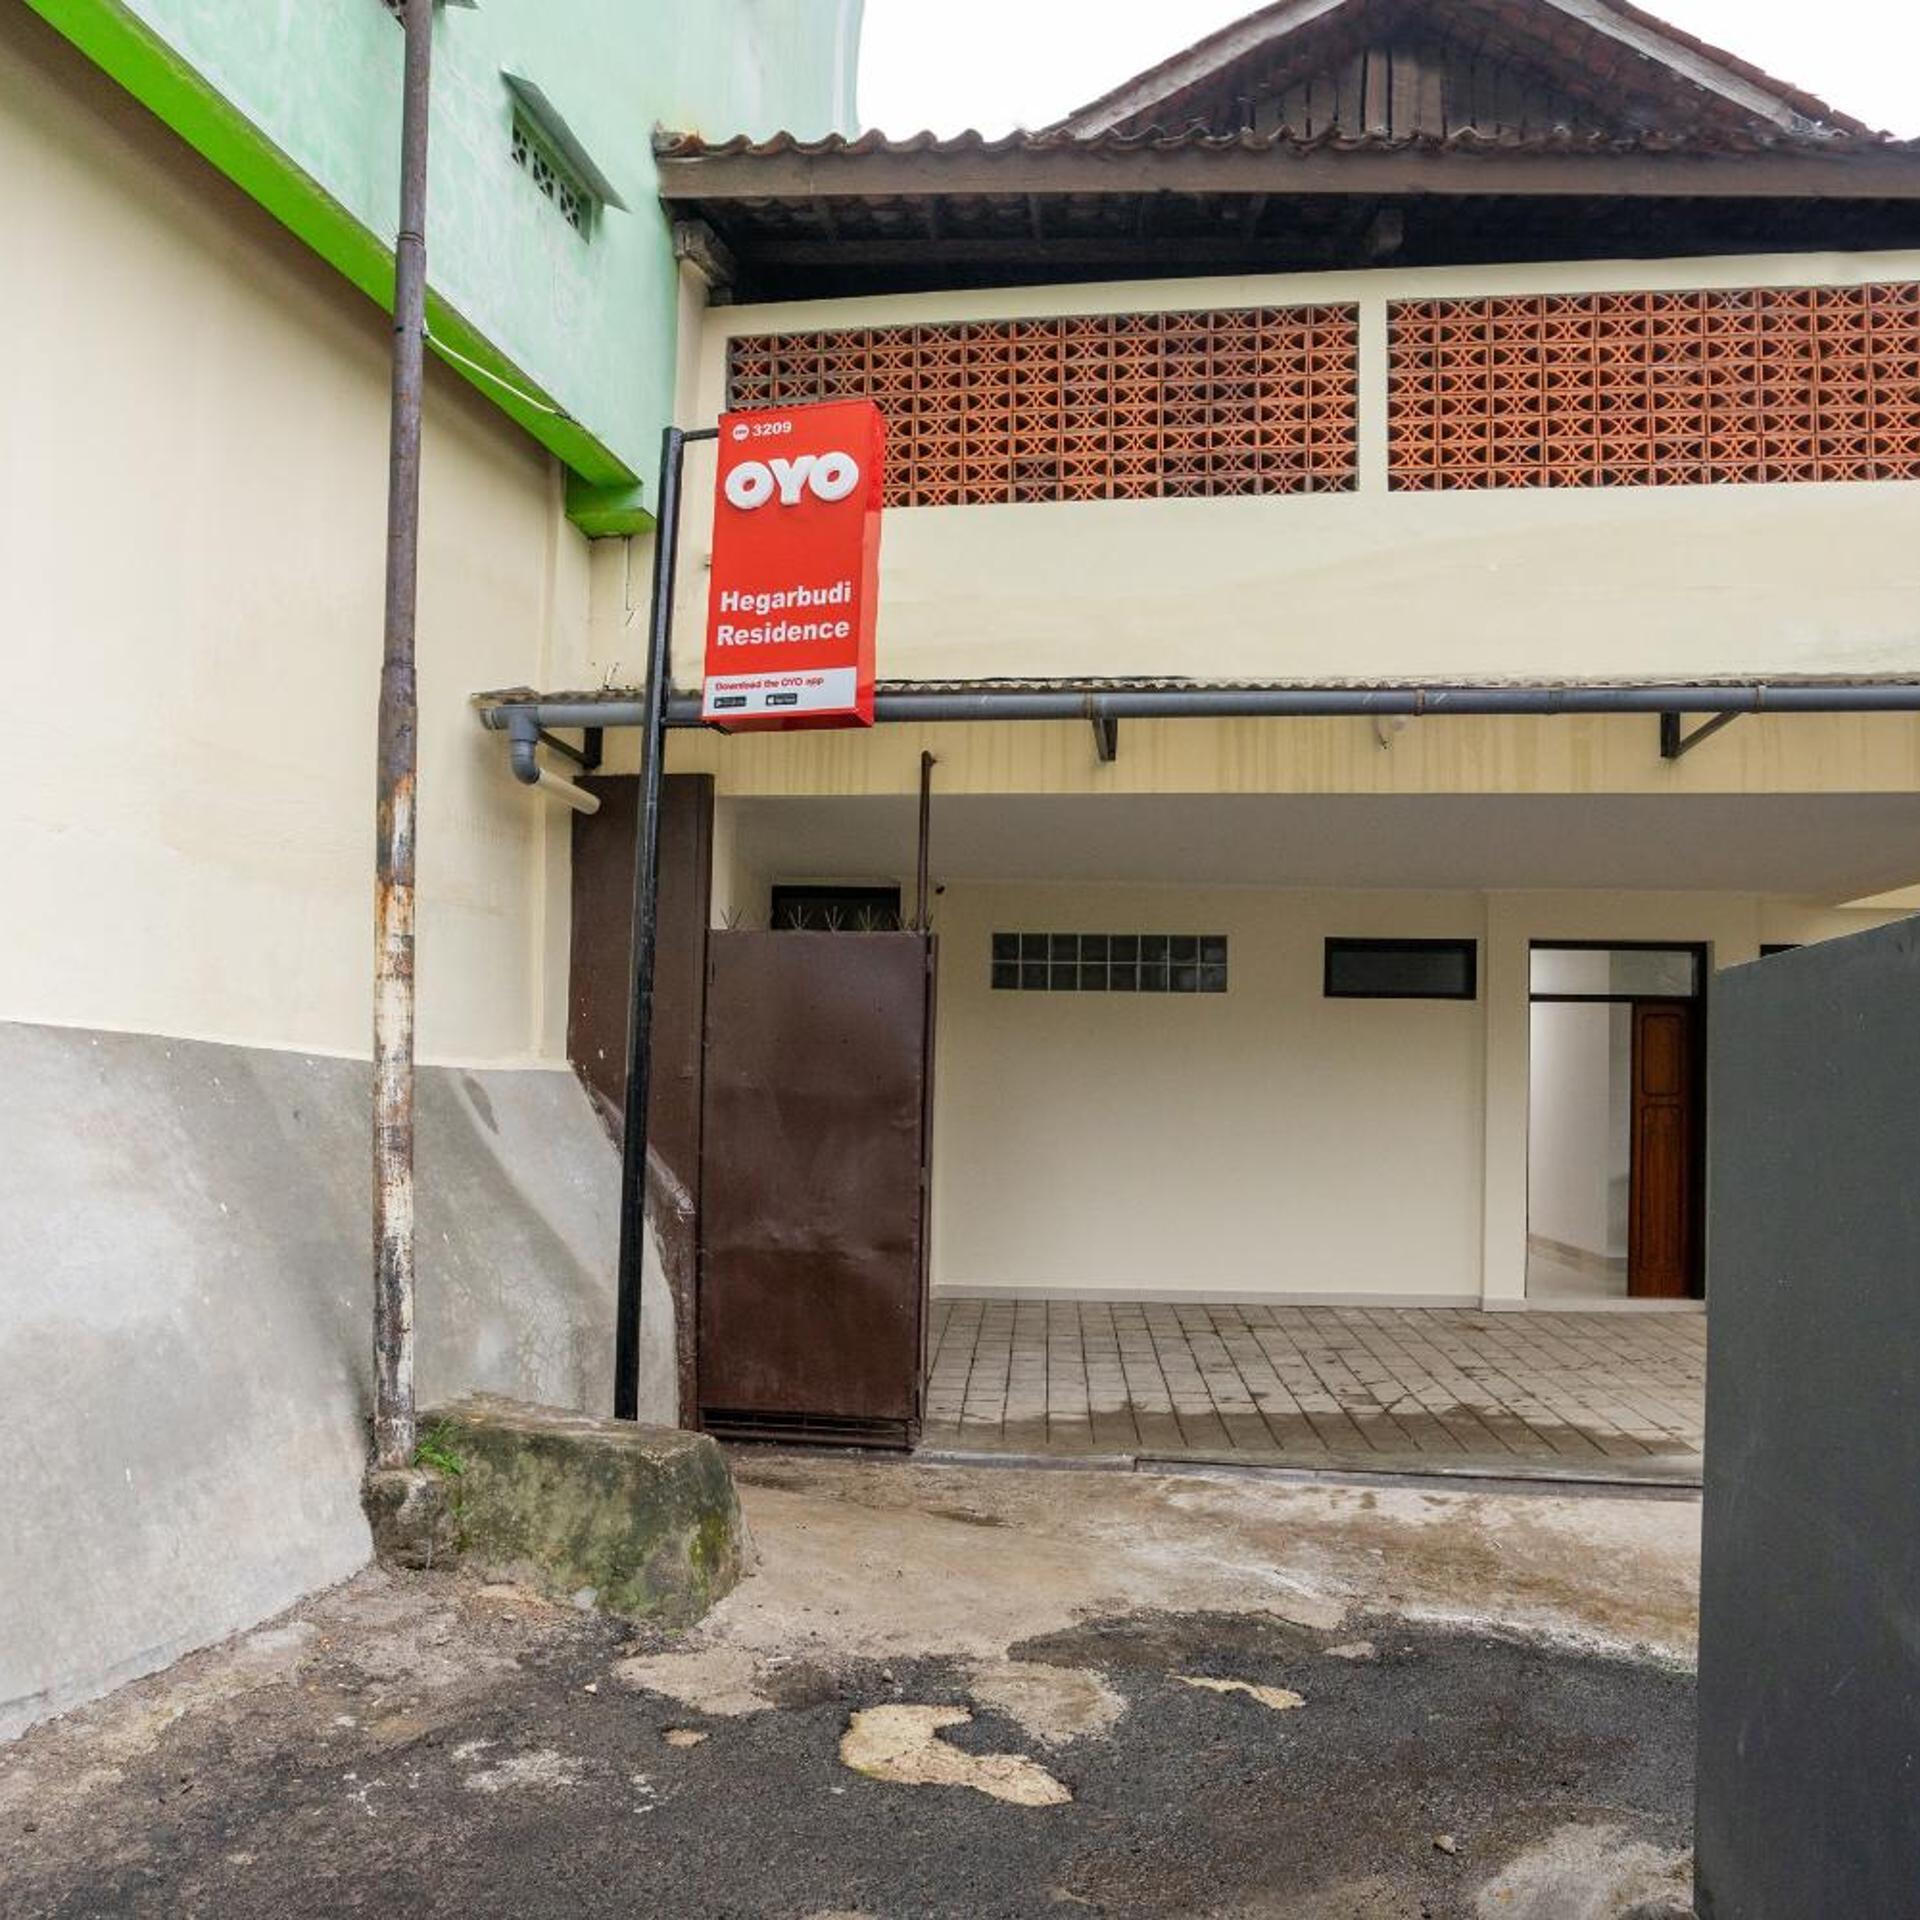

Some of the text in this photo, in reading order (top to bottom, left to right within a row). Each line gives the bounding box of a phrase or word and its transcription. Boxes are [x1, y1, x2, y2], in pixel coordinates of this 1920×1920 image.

[752, 421, 792, 437] 3209
[725, 451, 860, 510] OYO
[720, 581, 852, 615] Hegarbudi
[717, 620, 850, 647] Residence
[715, 677, 824, 691] Download the OYO app
